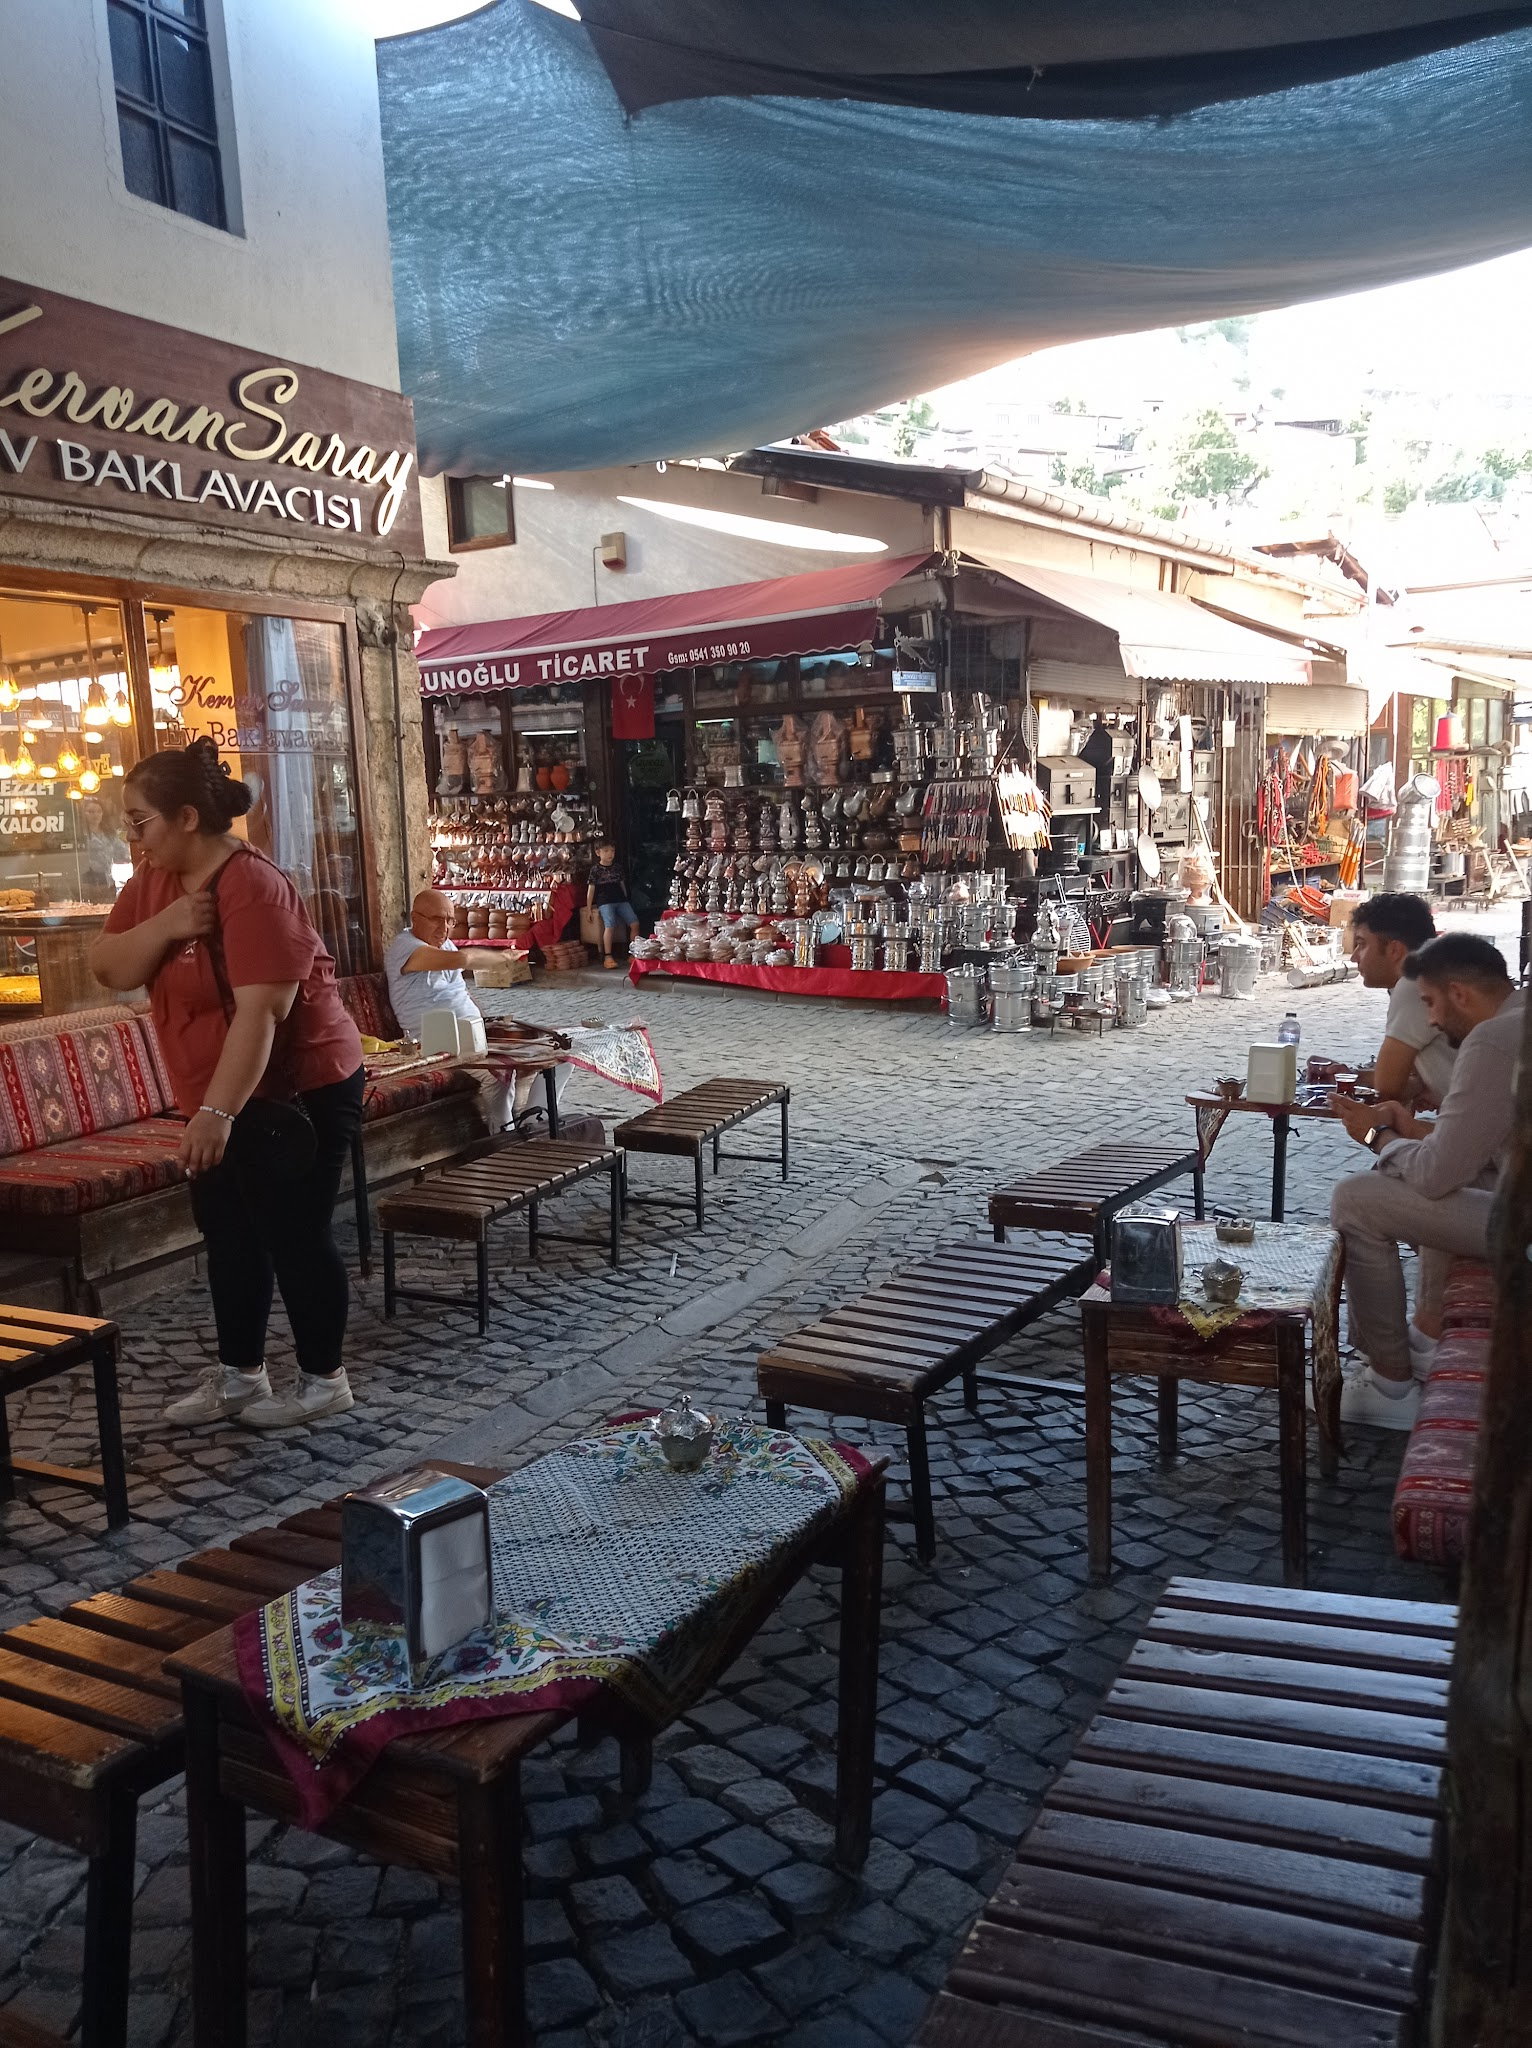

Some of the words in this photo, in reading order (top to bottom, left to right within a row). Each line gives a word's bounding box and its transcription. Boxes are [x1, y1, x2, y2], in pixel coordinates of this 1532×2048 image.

[58, 438, 362, 532] BAKLAVACISI
[537, 646, 650, 680] TİCARET
[668, 652, 688, 664] Gsm:
[689, 647, 709, 662] 0541
[710, 644, 726, 659] 350
[727, 642, 738, 656] 90
[739, 641, 750, 654] 20
[0, 779, 56, 797] EZZET
[0, 811, 64, 834] KALORİ
